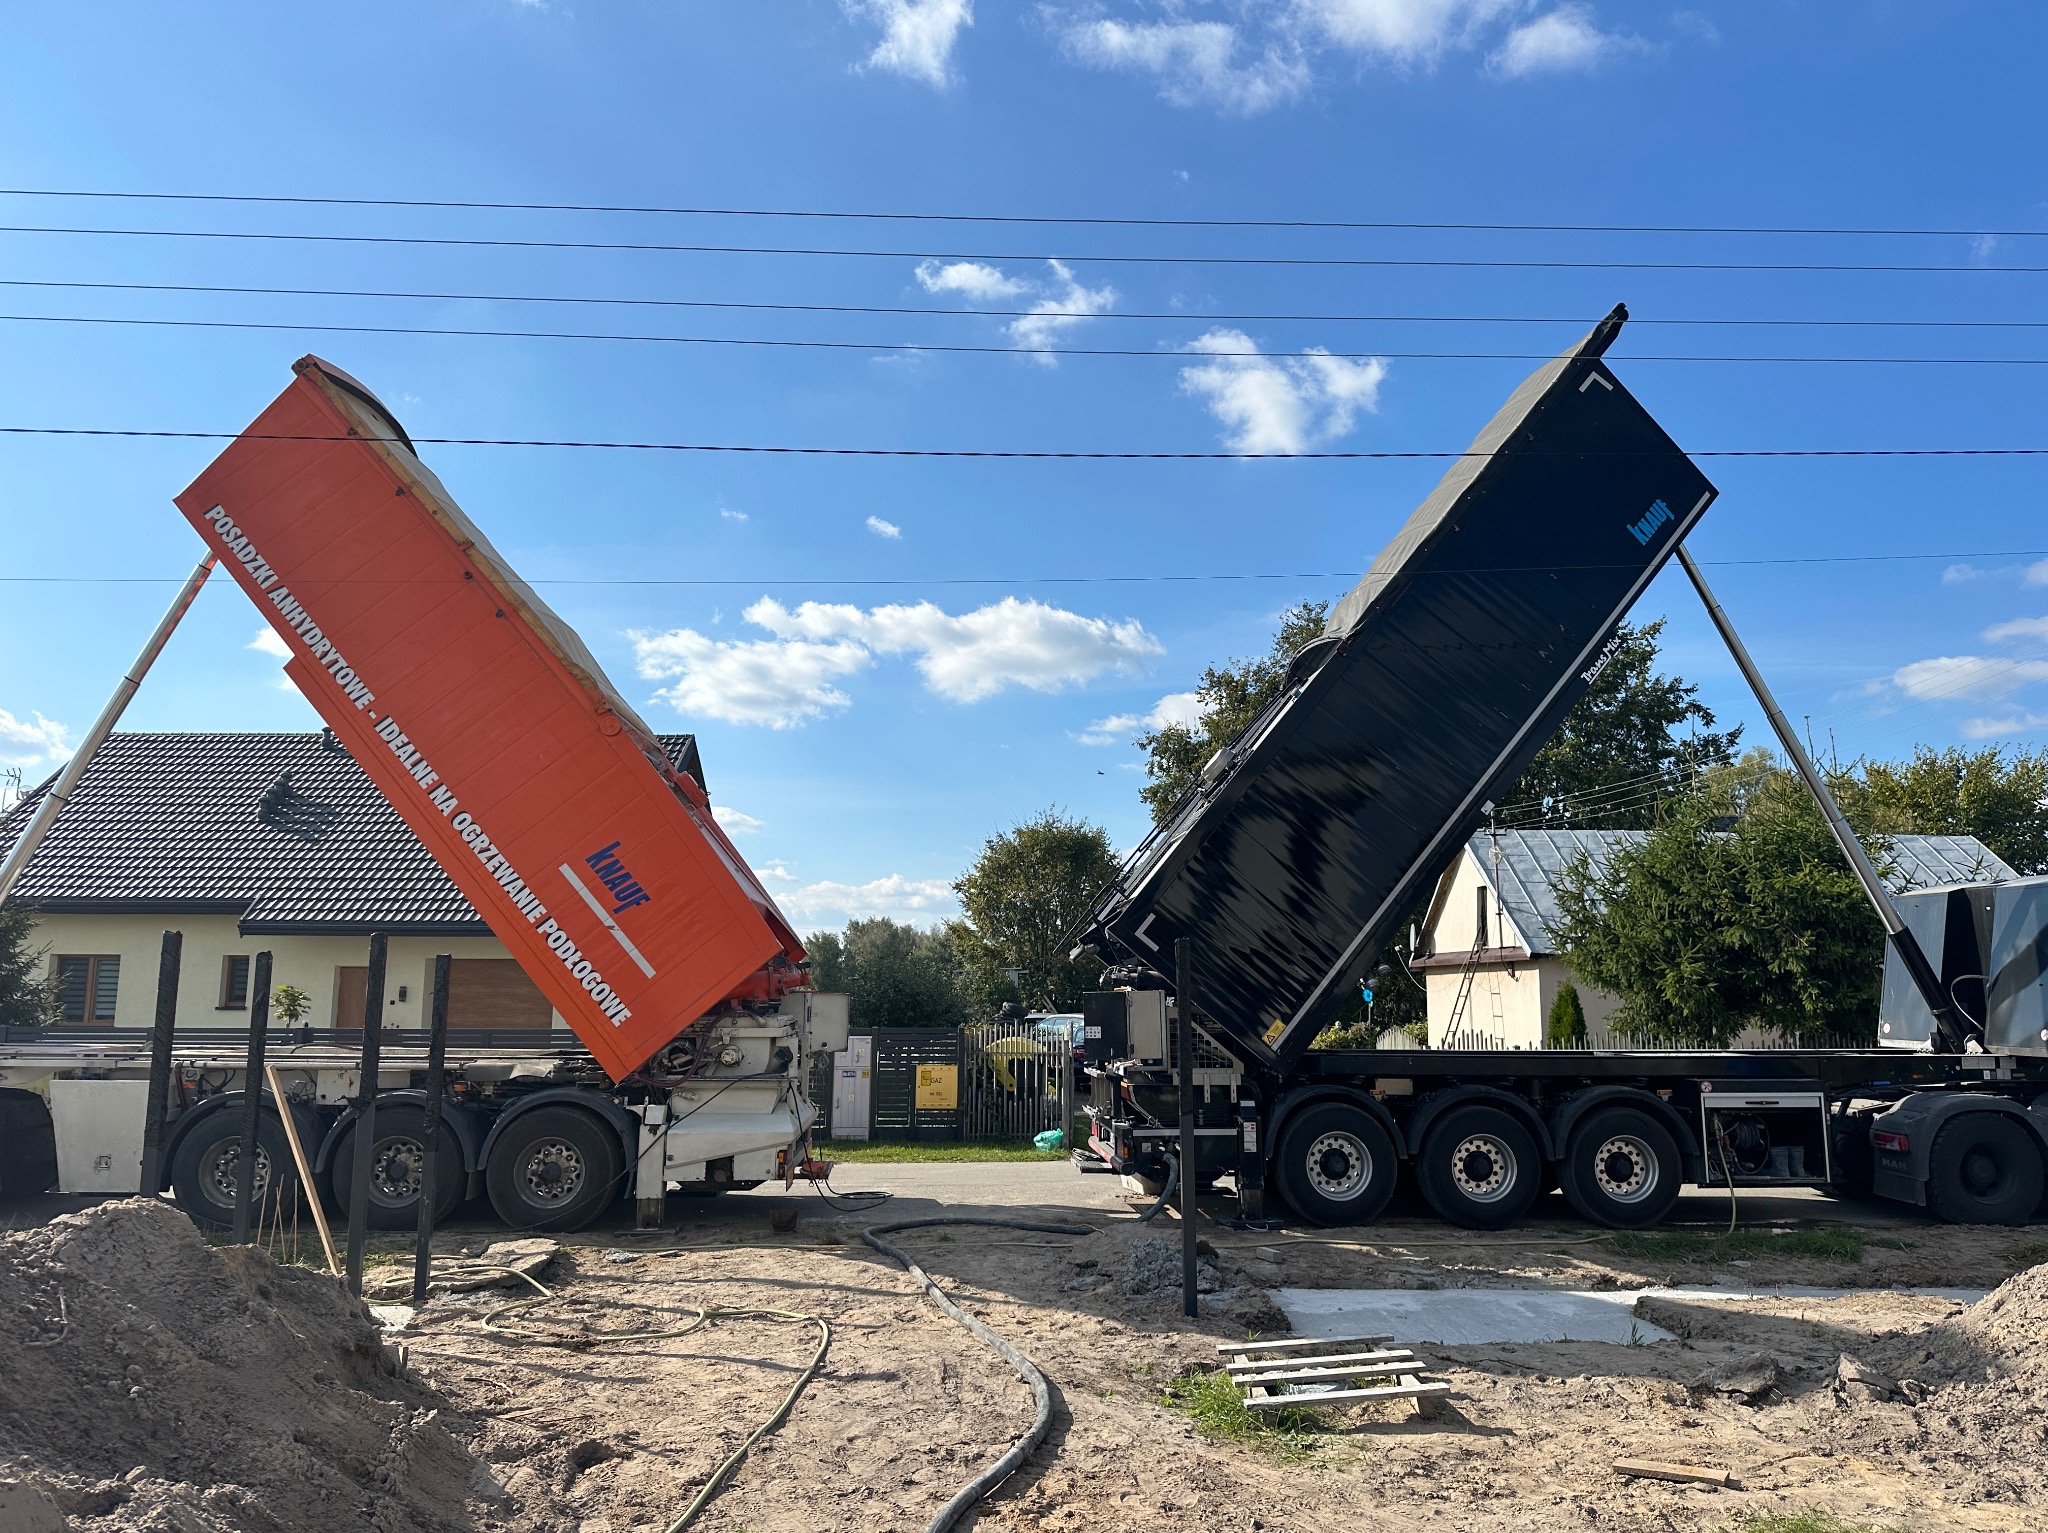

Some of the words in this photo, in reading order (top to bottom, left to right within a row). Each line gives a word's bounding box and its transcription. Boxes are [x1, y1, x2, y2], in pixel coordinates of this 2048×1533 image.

[1626, 499, 1674, 546] KNAUF
[203, 503, 279, 589] POSADZKI
[267, 585, 375, 710] ANHYDRYTOWE
[367, 709, 376, 719] -
[373, 715, 439, 790] IDEALNE
[428, 783, 459, 817] NA
[450, 811, 547, 924] OGRZEWANIE
[536, 916, 632, 1027] PODŁOGOWE
[584, 840, 652, 915] KNAUF
[1881, 1157, 1907, 1170] MAN
